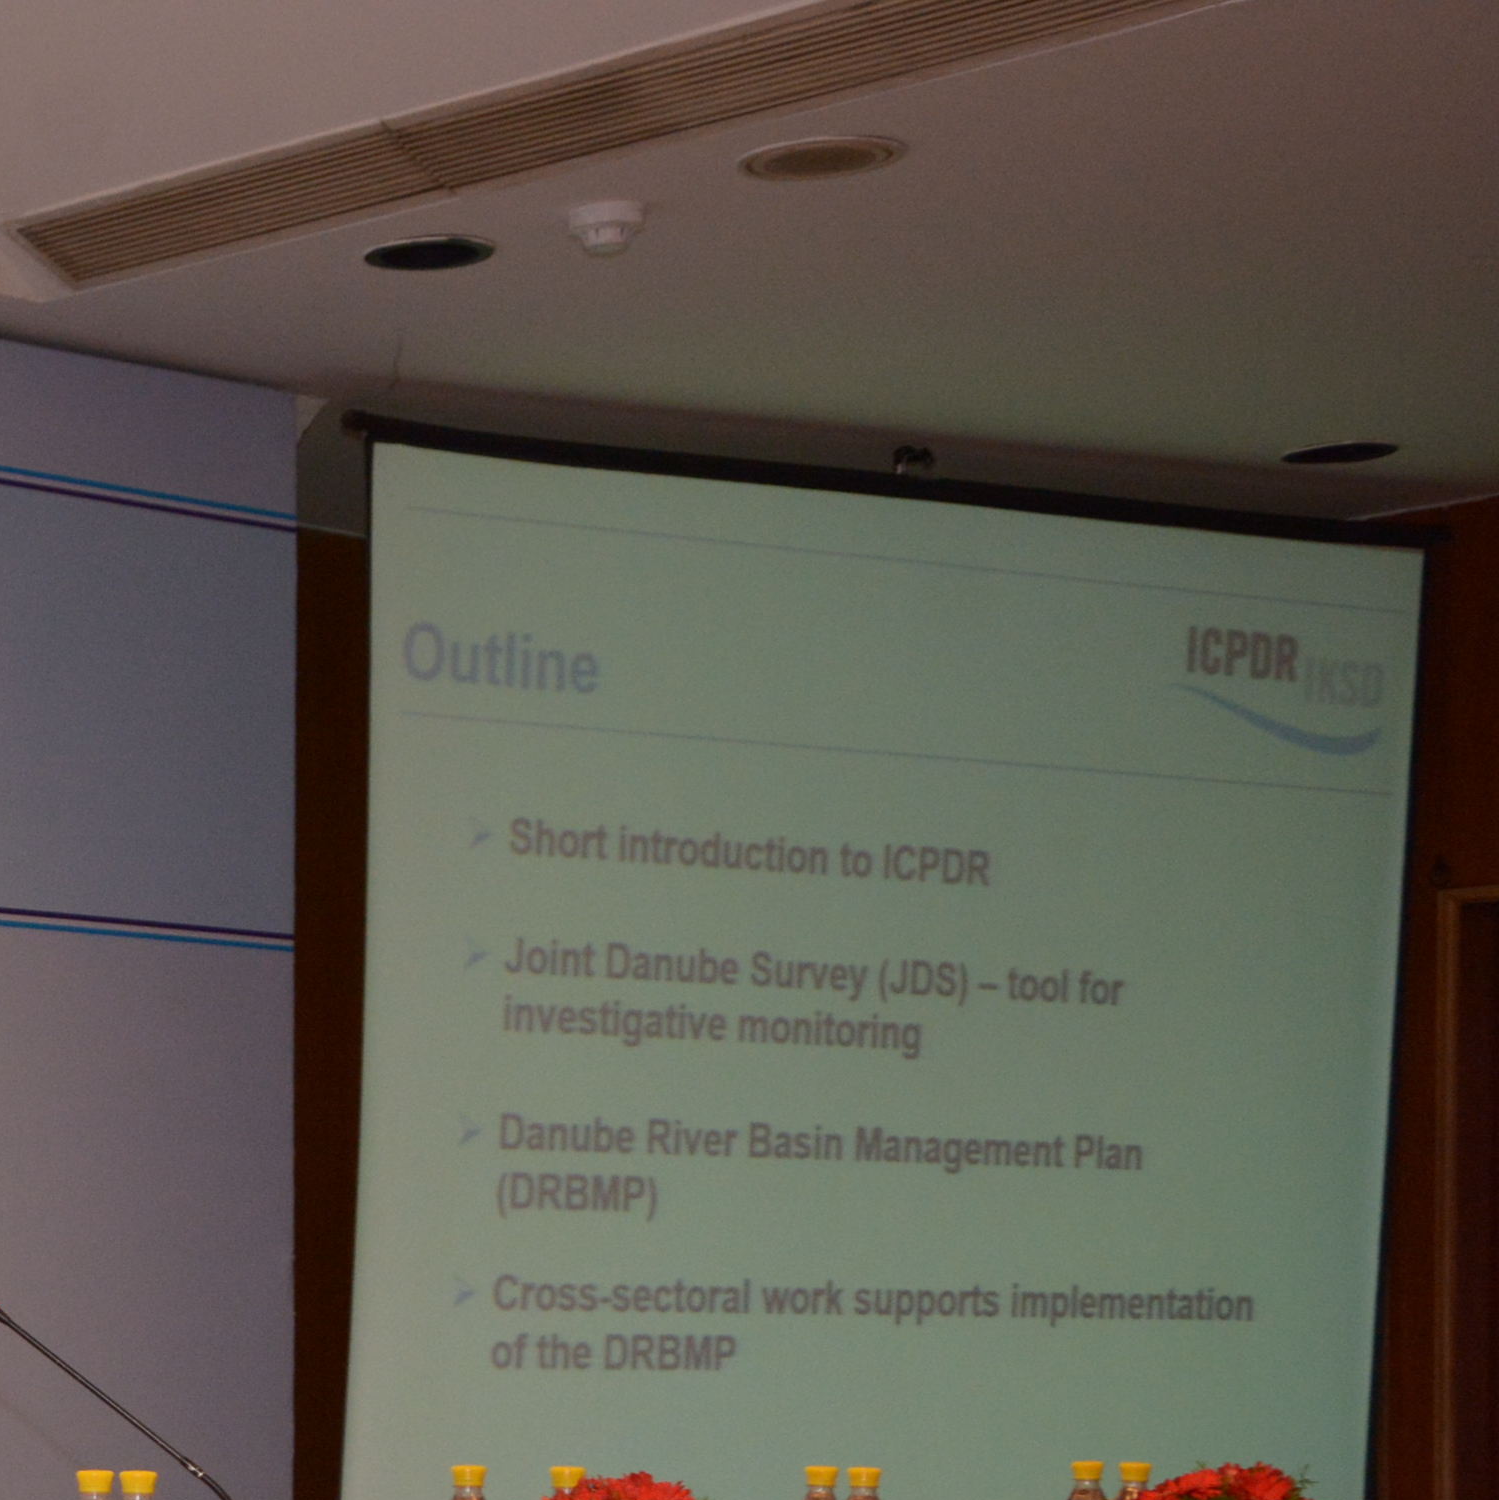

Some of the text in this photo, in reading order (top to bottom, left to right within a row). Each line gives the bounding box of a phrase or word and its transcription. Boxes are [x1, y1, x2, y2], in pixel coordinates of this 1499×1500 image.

[404, 623, 600, 694] Outline
[1186, 626, 1299, 683] ICPDR
[510, 817, 990, 886] Short introduction to ICPDR
[505, 938, 596, 978] Joint
[606, 942, 739, 985] Danube
[751, 952, 867, 1000] Survey
[878, 958, 969, 1006] (JDS)
[1007, 967, 1070, 1003] tool
[1080, 970, 1123, 1006] for
[504, 996, 922, 1059] investigative monitoring
[498, 1113, 1143, 1174] Danube River Basin Management Plan
[496, 1173, 658, 1221] (DRBMP)
[493, 1275, 1255, 1327] Cross-sectoral work supports implementation
[492, 1334, 737, 1372] of the DRBMP
